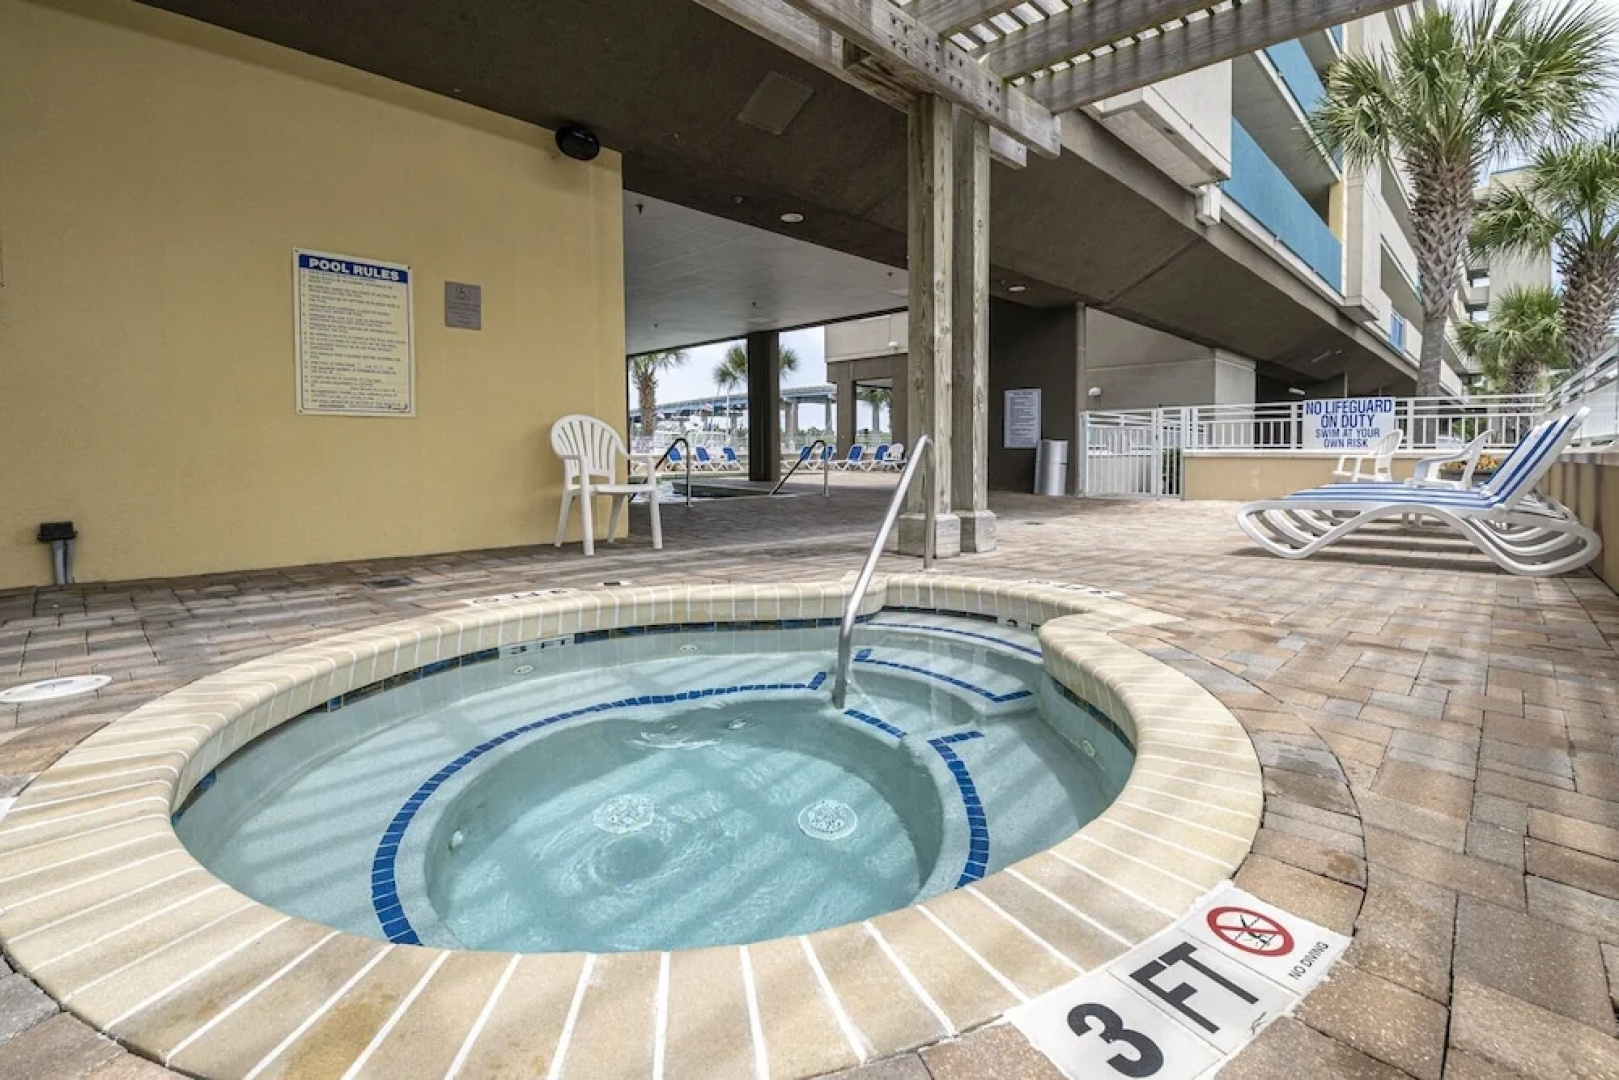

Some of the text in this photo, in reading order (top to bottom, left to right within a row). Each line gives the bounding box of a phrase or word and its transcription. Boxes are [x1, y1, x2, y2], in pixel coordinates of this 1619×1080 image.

[309, 258, 399, 280] POOL RULES
[1306, 399, 1392, 415] NO LIFEGUARD
[1320, 414, 1375, 428] ON DUTY
[1315, 428, 1380, 438] SWIM AT YOUR
[1323, 438, 1368, 448] OWN RISK
[1288, 941, 1329, 980] NO DIVING
[1066, 941, 1259, 1078] 3 FT
